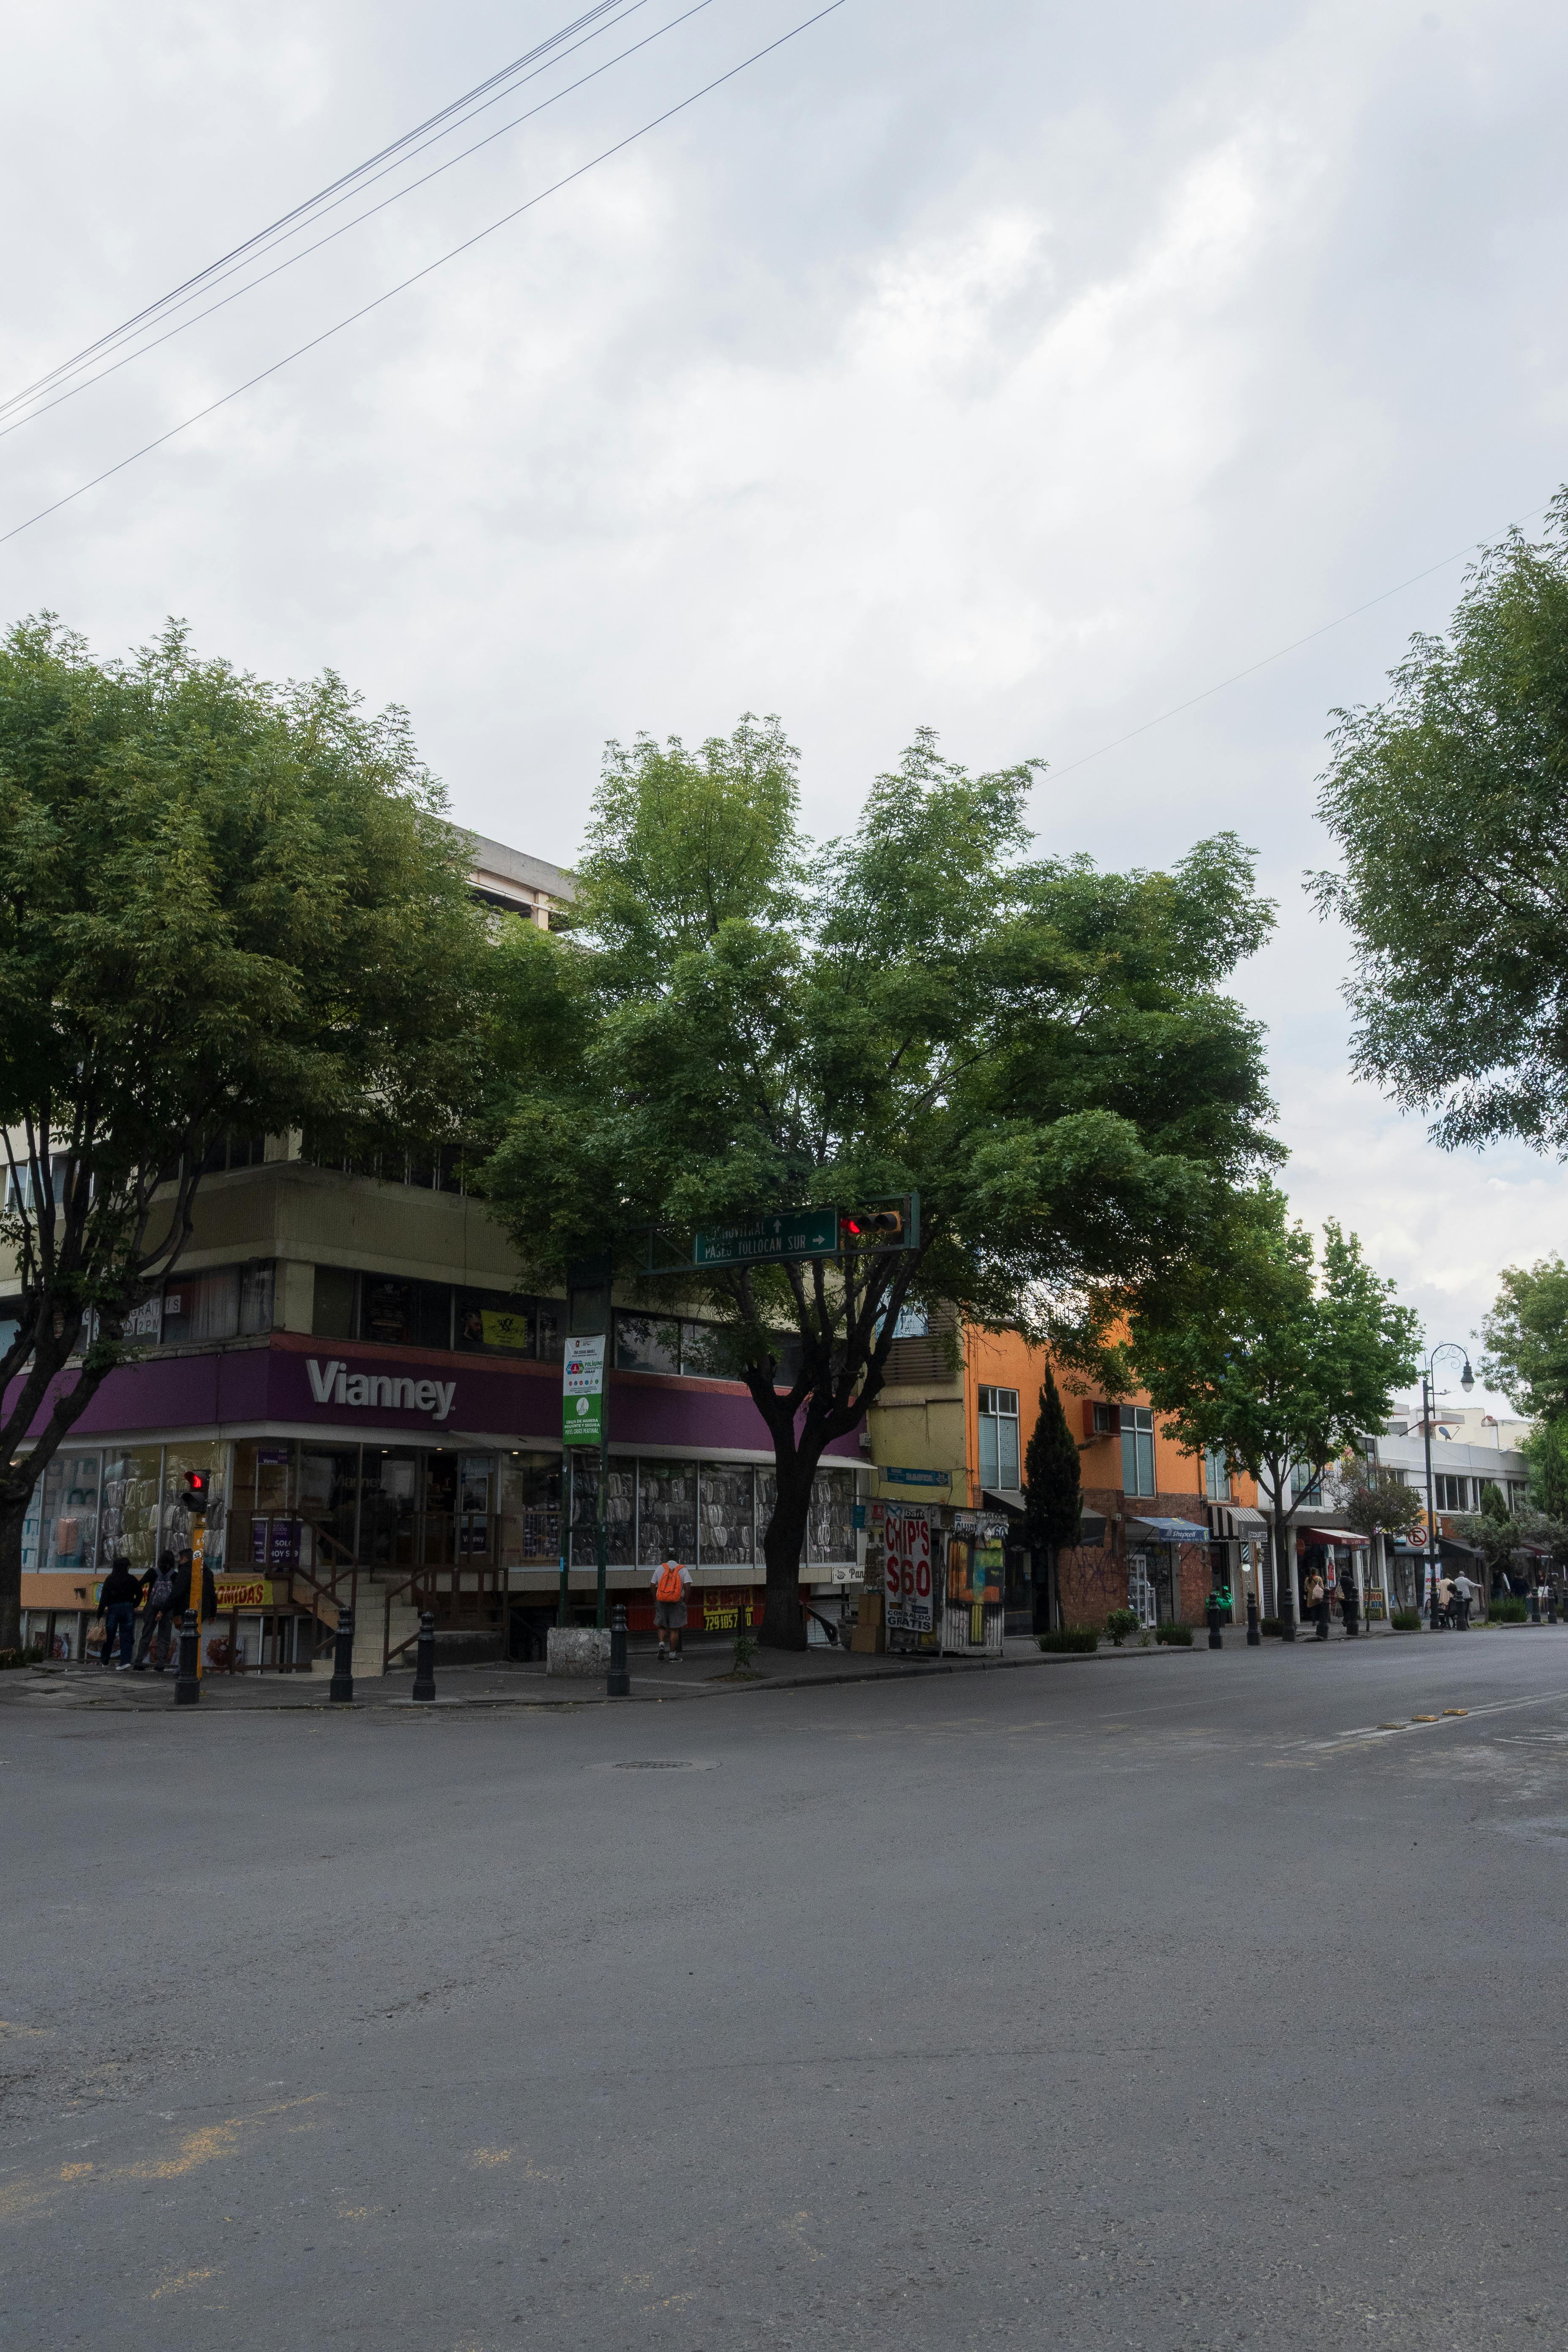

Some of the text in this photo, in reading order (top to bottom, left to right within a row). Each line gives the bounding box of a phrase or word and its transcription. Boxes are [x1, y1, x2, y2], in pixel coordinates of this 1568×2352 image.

[705, 1235, 806, 1259] PASEO TOLLOCAN SUR
[305, 1359, 457, 1420] Vianney
[905, 1509, 925, 1518] bait
[886, 1516, 929, 1556] CHIP'S
[887, 1554, 930, 1597] $60
[215, 1584, 264, 1605] OMIDAS
[888, 1616, 931, 1630] GRATIS
[903, 1612, 931, 1621] SALDO
